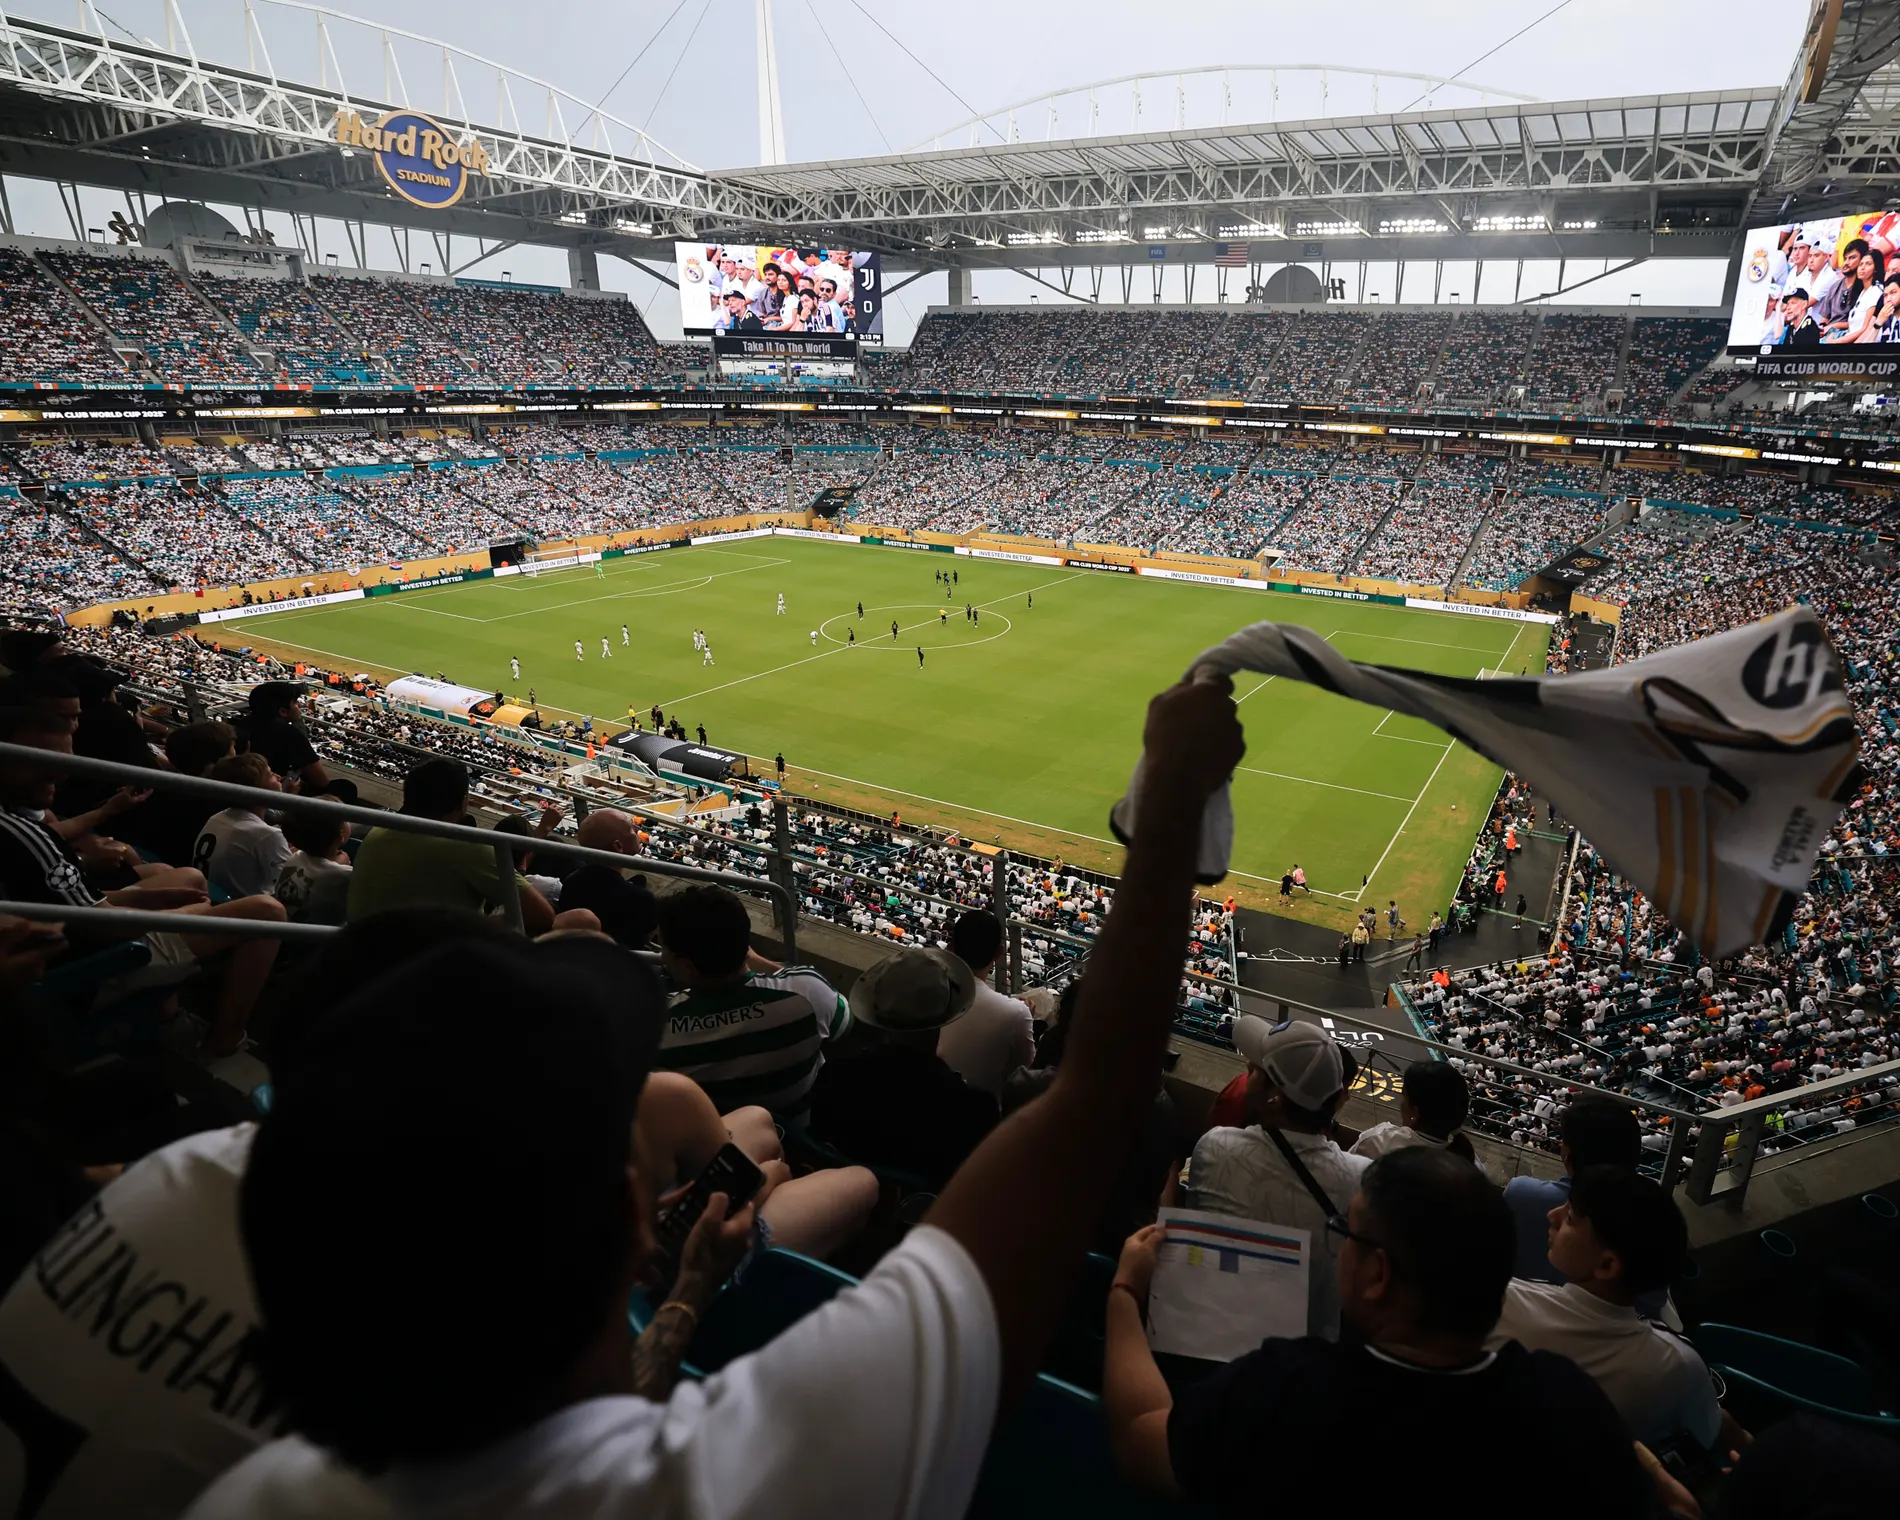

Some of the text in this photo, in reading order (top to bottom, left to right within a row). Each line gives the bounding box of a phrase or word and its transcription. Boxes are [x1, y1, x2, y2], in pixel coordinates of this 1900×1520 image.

[335, 111, 492, 178] Hard Rock
[396, 169, 451, 188] STADIUM
[92, 246, 109, 254] 303
[863, 300, 873, 313] 0
[743, 341, 831, 354] Take It To The World
[1757, 362, 1897, 374] FIFA CLUB WORLD CUP
[42, 411, 63, 419] FIFA
[64, 411, 89, 419] CLUB
[1840, 432, 1871, 440] RICHMOND
[1604, 439, 1626, 447] WORLD
[1762, 451, 1774, 459] FIFA
[1789, 454, 1810, 462] WORLD
[1810, 455, 1823, 463] CUP
[1862, 460, 1894, 470] FIFA CLUB
[624, 546, 648, 555] INVESTED
[654, 543, 671, 551] BETTER
[911, 542, 929, 550] BETTER
[978, 550, 1005, 559] INVESTED
[521, 562, 549, 571] INVESTED
[557, 558, 576, 566] BETTER
[399, 580, 431, 591] INVESTED
[440, 575, 464, 585] BETTER
[1171, 571, 1202, 581] INVESTED
[1211, 576, 1235, 584] BETTER
[1301, 586, 1334, 597] INVESTED
[1334, 590, 1342, 598] IN
[243, 597, 327, 615] INVESTED IN BETTER
[1442, 603, 1481, 614] INVESTED
[1492, 609, 1522, 619] BETTER
[671, 1002, 766, 1035] MAGNERS
